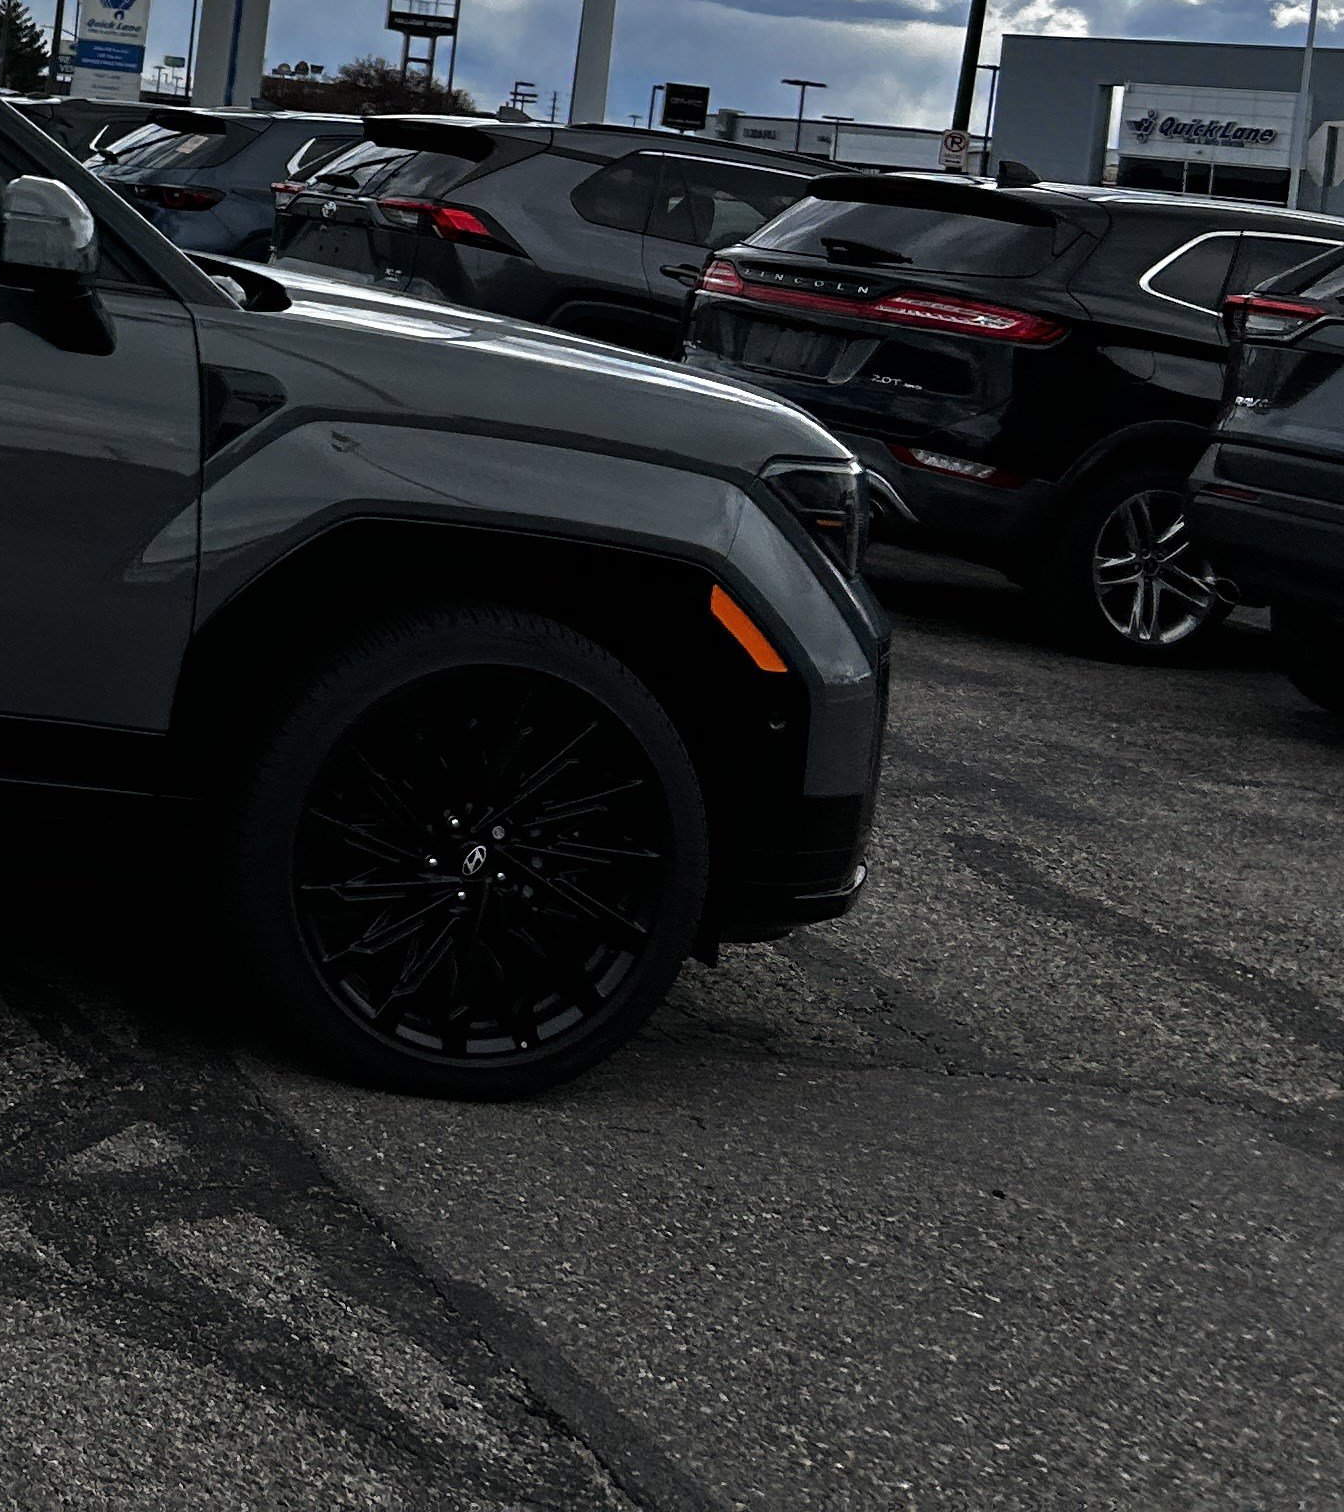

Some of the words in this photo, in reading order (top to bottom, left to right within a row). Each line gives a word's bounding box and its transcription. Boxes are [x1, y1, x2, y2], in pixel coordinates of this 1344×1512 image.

[87, 18, 115, 29] Quick
[116, 20, 143, 33] Lane
[1159, 116, 1219, 138] Quick
[1218, 119, 1274, 142] Lane
[744, 268, 869, 294] LINCOLN
